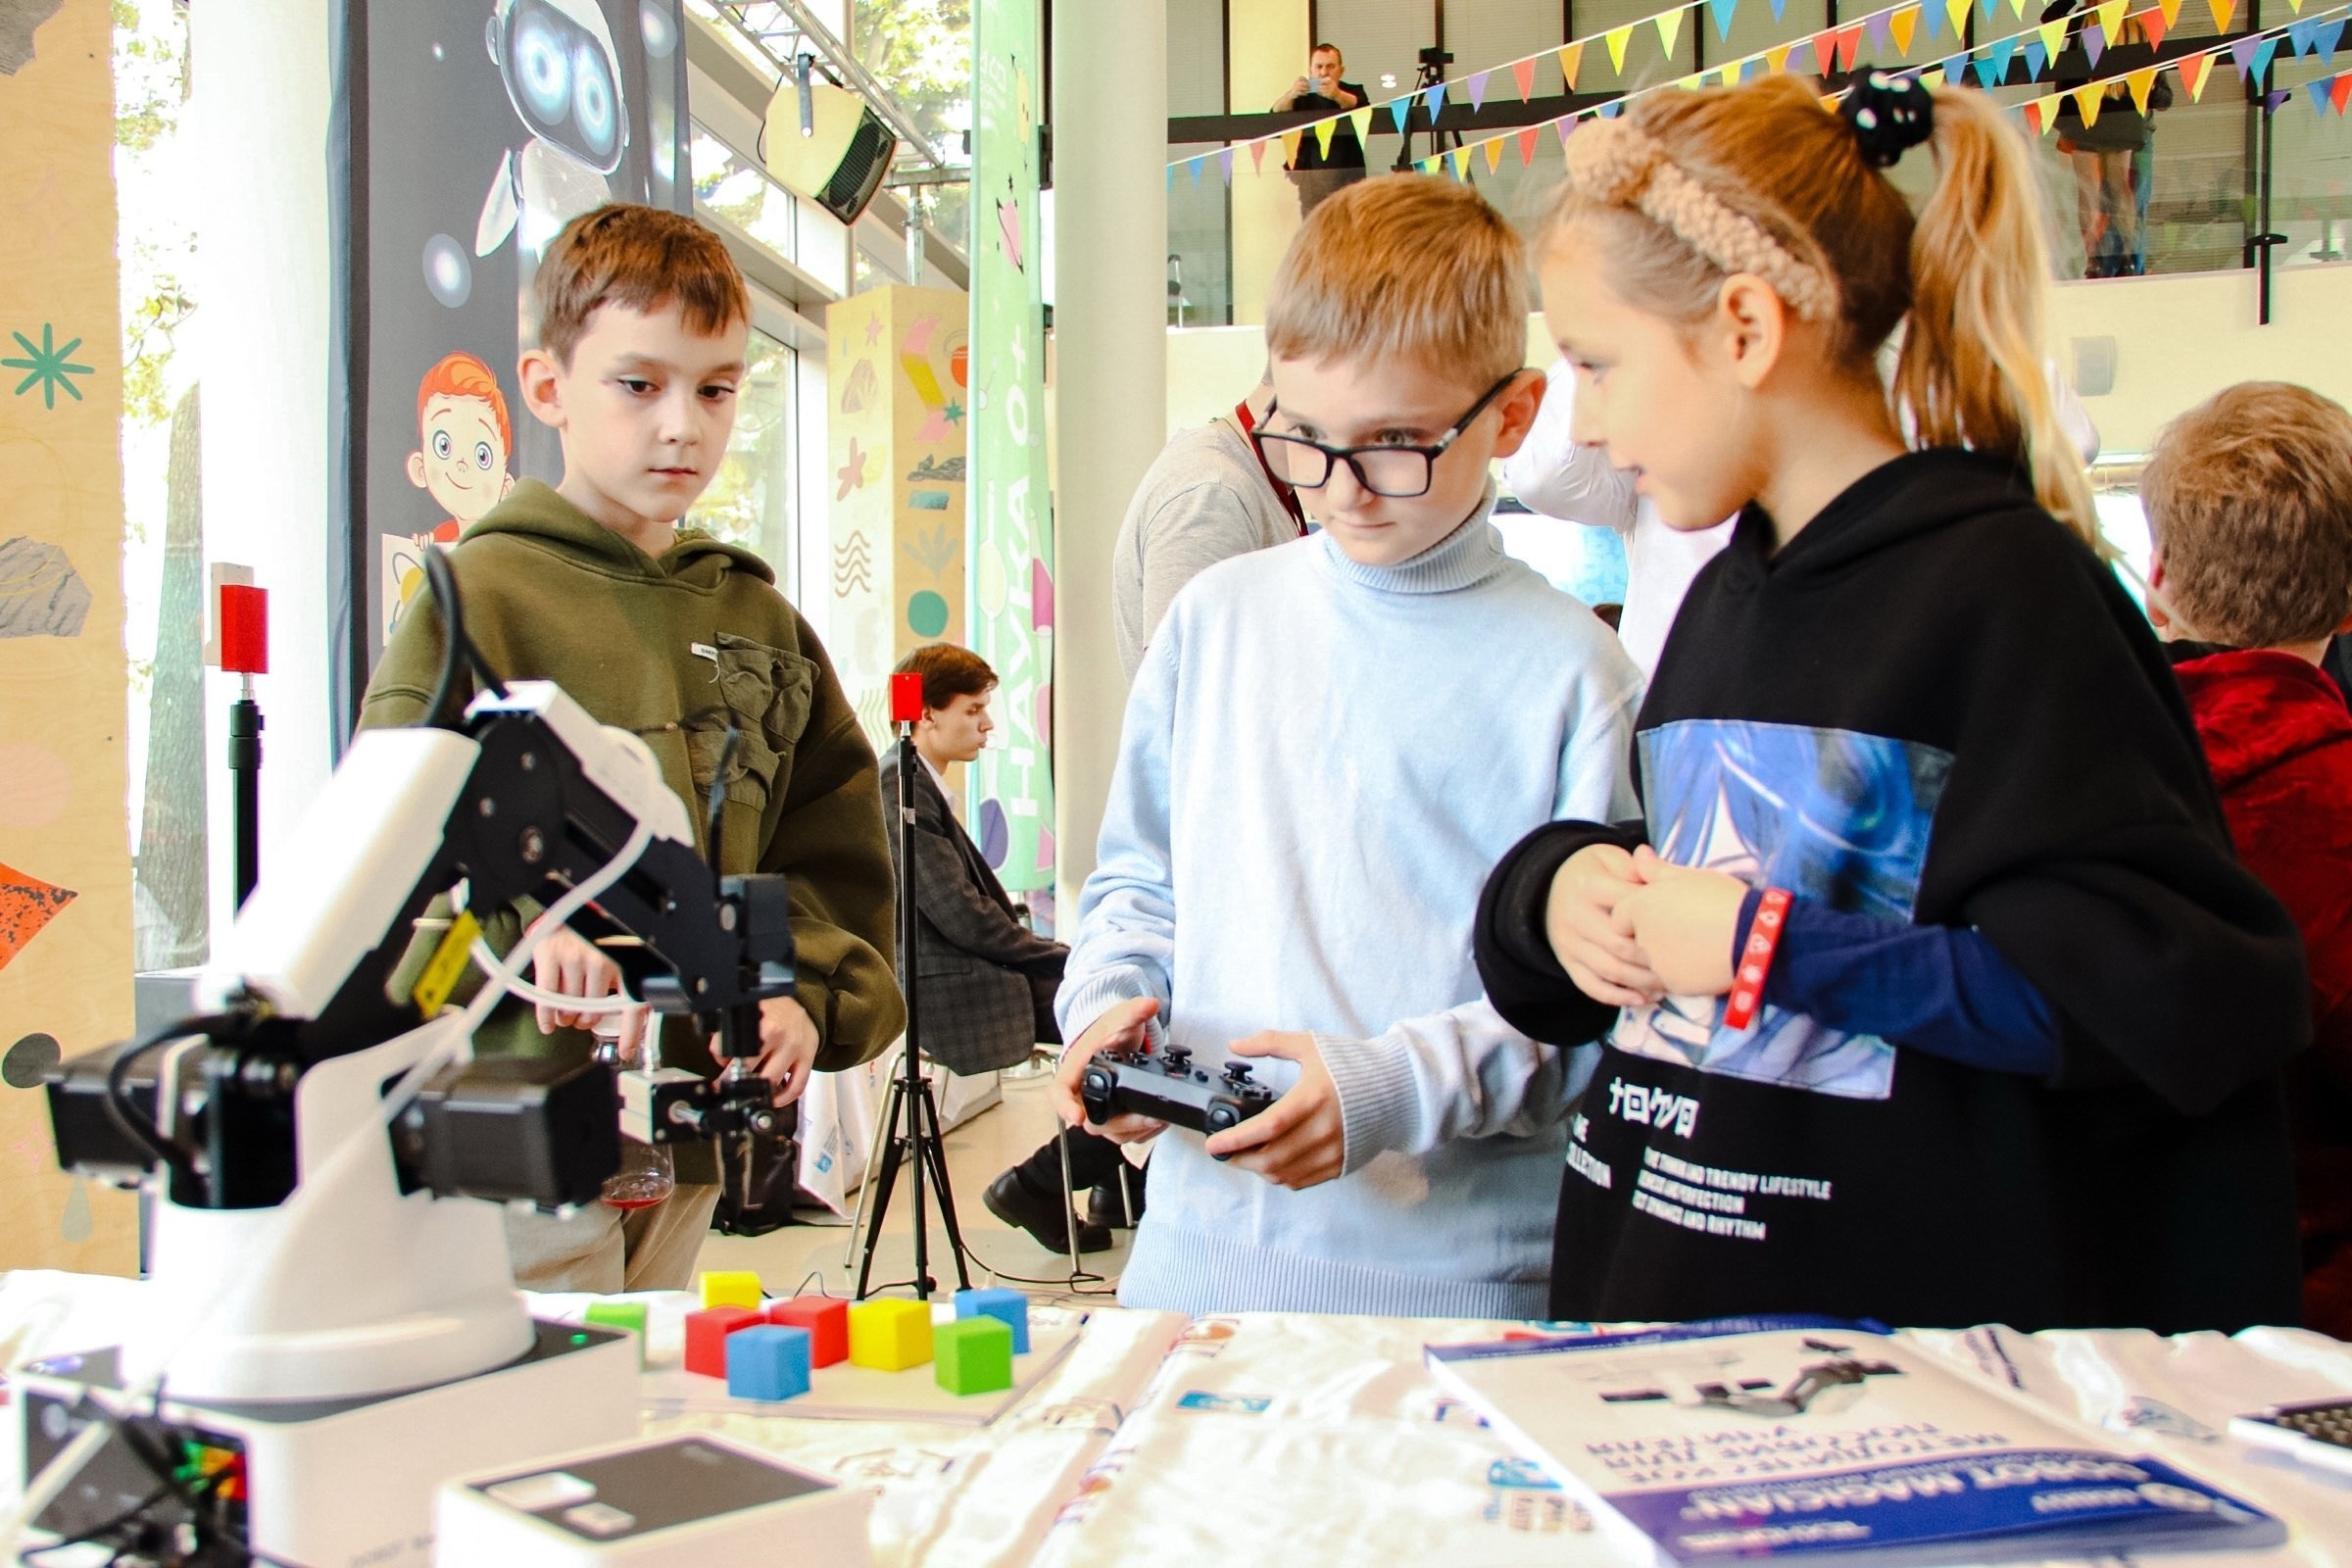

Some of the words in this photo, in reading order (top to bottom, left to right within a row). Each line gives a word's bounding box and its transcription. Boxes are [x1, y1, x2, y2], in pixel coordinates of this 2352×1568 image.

[1006, 474, 1039, 816] НАУКА
[1706, 1167, 1759, 1193] TRENDY
[1760, 1174, 1833, 1200] LIFESTYLE
[1707, 1214, 1766, 1241] RHYTHM
